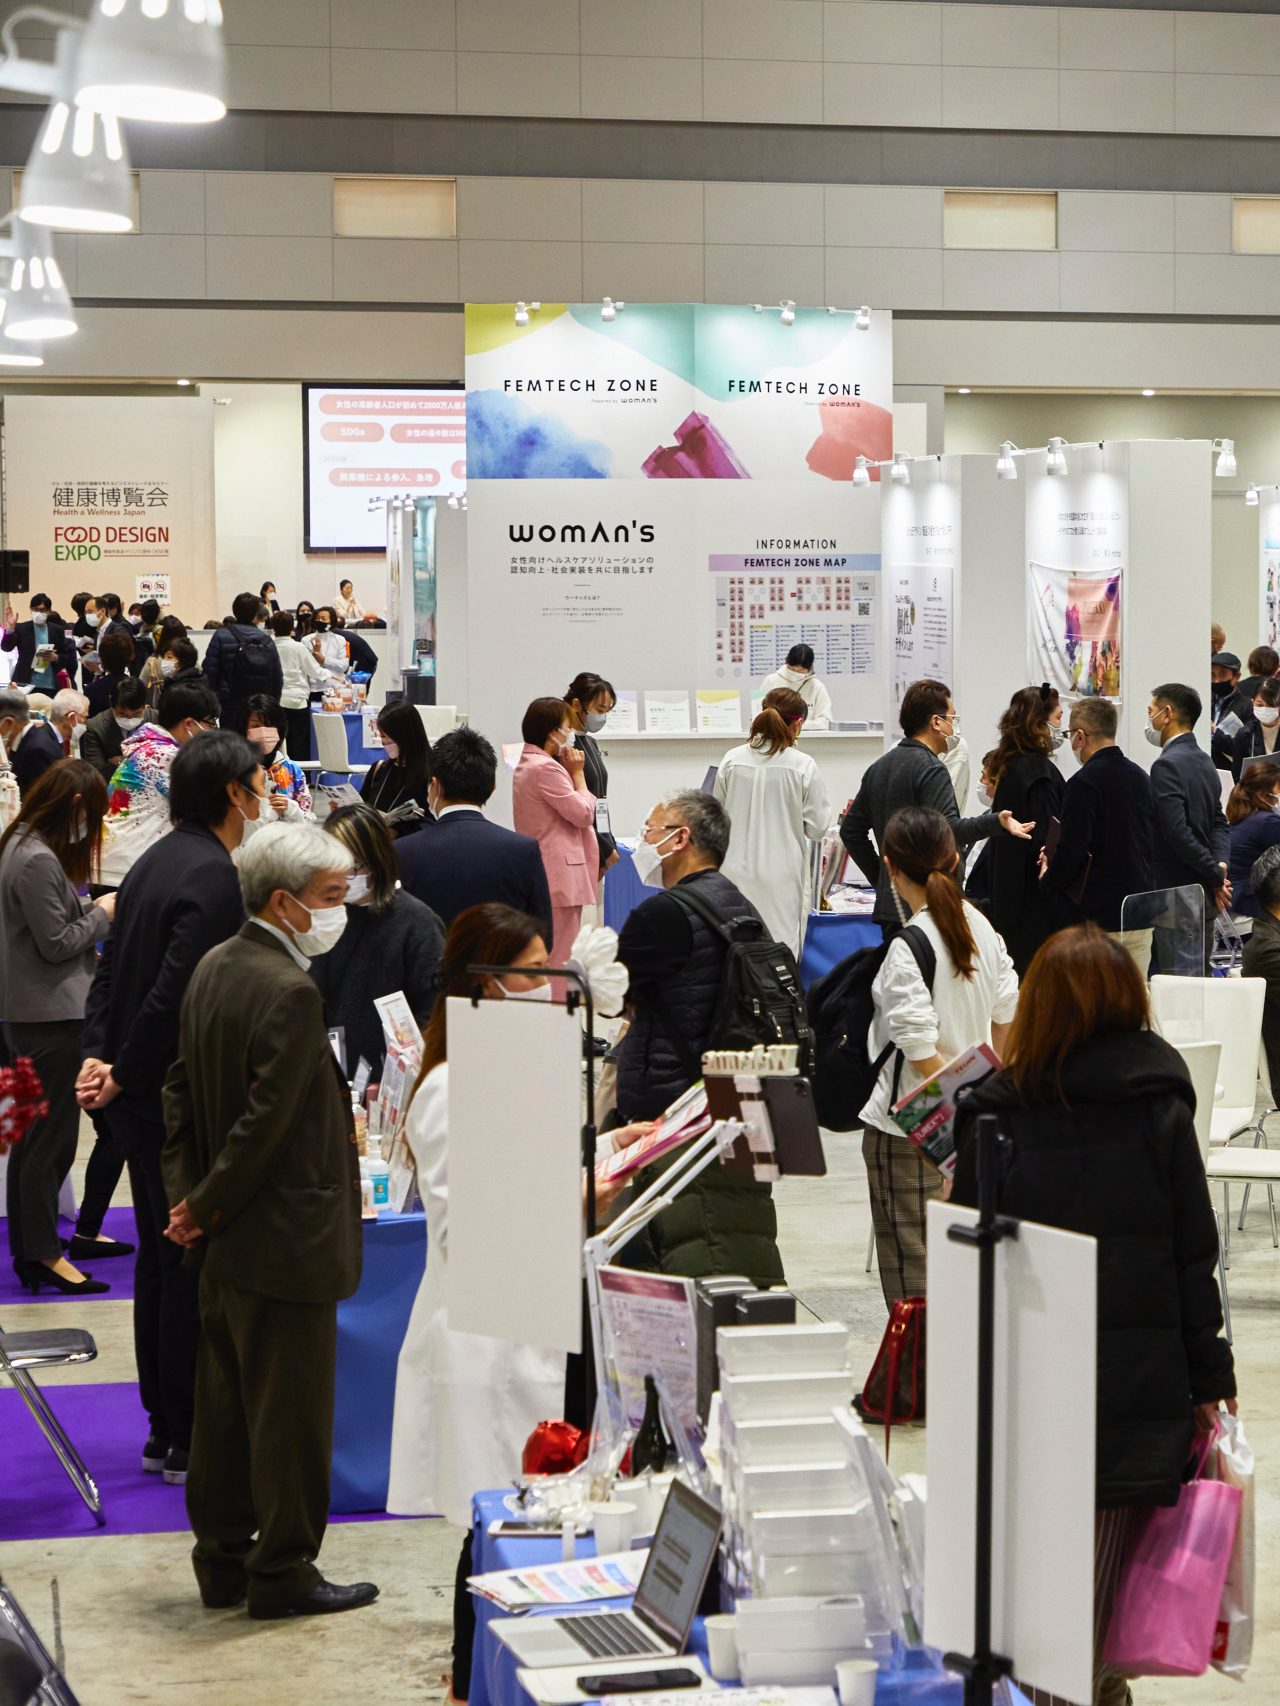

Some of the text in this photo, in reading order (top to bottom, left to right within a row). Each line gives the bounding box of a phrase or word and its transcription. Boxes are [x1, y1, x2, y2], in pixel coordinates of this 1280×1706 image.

[504, 379, 658, 392] FEMTECH ZONE
[728, 380, 861, 396] FEMTECH ZONE
[52, 487, 168, 507] 健康博覧会
[53, 508, 78, 516] Health
[87, 508, 120, 516] Wellness
[123, 508, 146, 518] Japan
[54, 526, 169, 543] FOOD DESIGN
[756, 539, 837, 550] INFORMATION
[54, 545, 101, 561] EXPO
[510, 556, 654, 565] 女性向けヘルスケアソリューションの
[744, 558, 847, 567] FEMTECH ZONE MAP
[510, 566, 655, 575] 認知向上・社会実装を共に目指します
